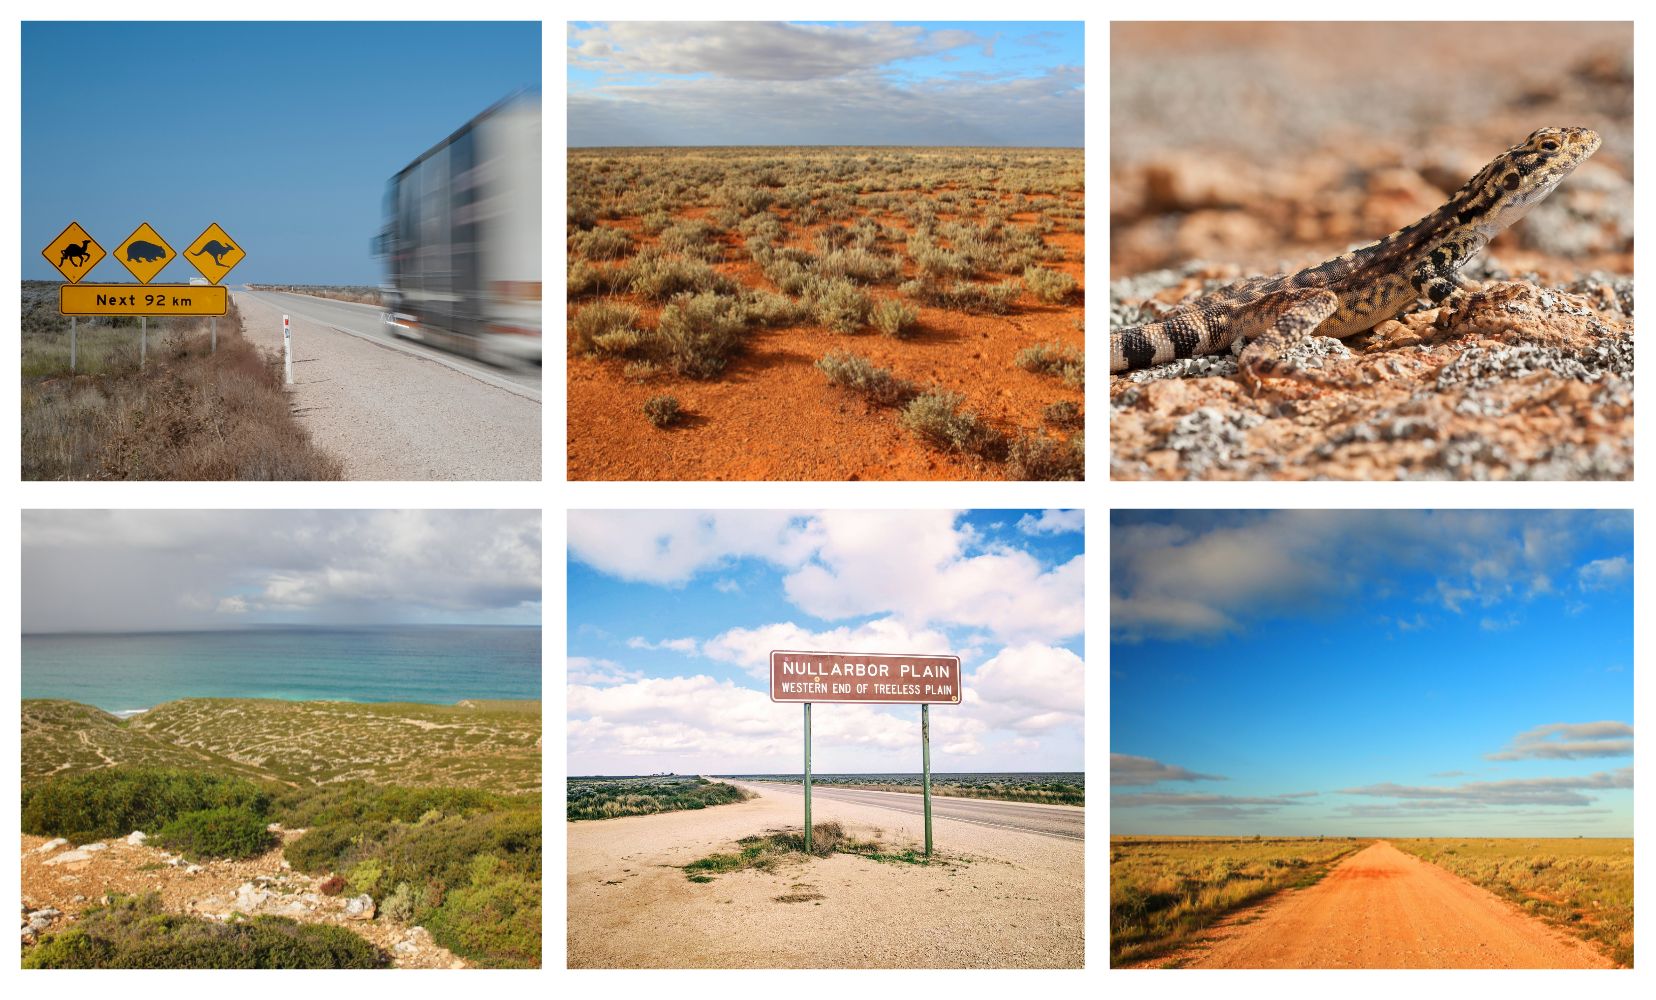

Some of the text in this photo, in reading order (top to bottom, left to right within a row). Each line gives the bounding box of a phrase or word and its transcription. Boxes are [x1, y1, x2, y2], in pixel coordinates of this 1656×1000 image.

[96, 294, 192, 307] Next 92 km
[783, 661, 950, 678] NULLARBOR PLAIN
[782, 682, 952, 695] WESTERN END OF TREELESS PLAIN
